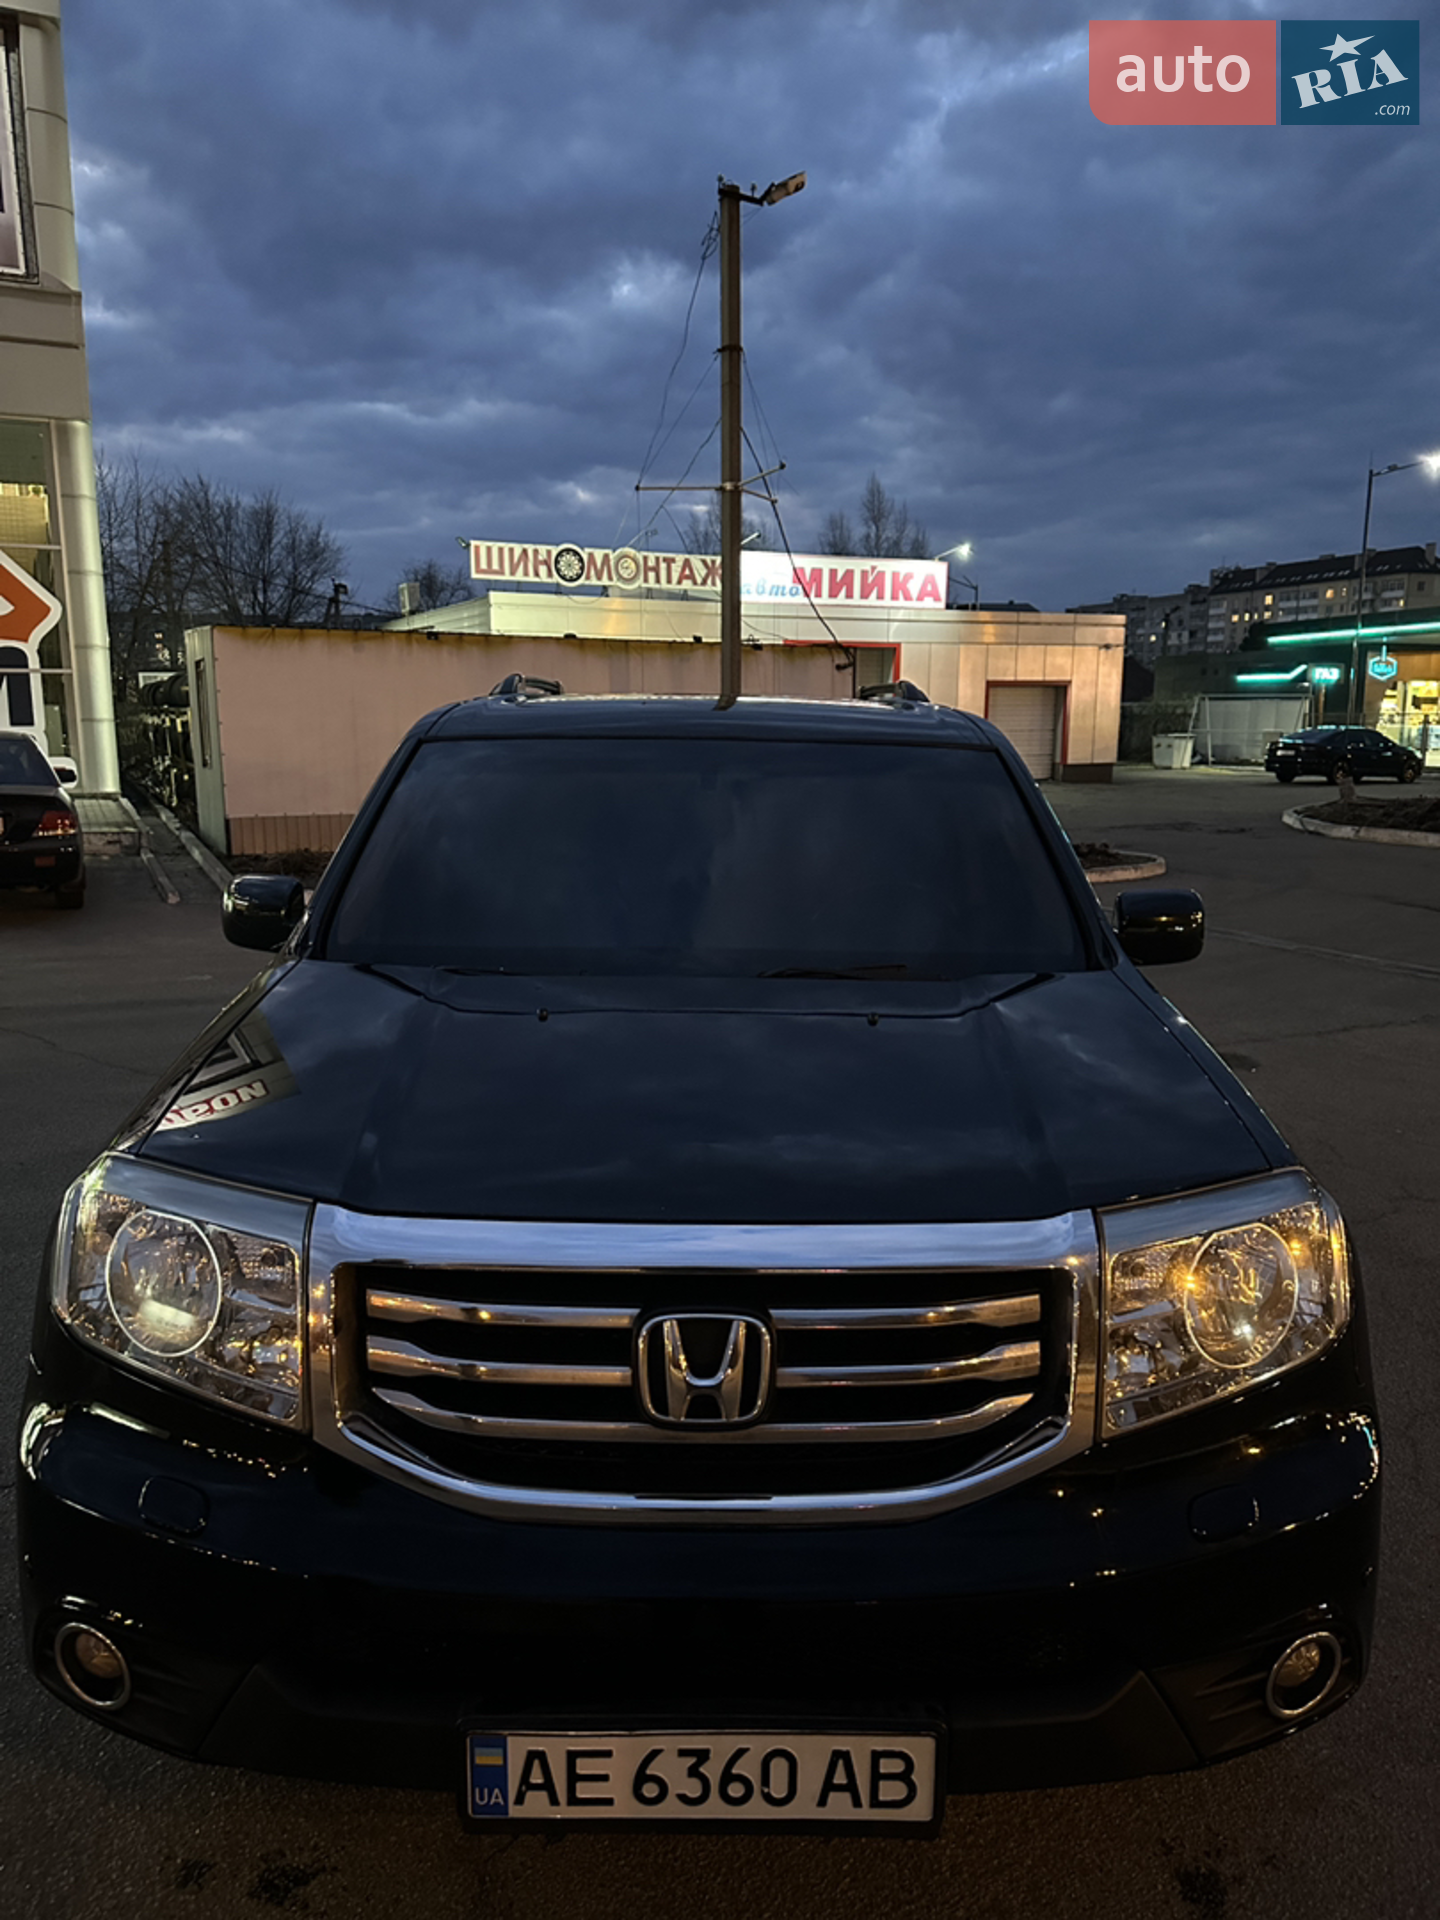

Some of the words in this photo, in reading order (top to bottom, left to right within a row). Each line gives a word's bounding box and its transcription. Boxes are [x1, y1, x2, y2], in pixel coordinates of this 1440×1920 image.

[474, 1787, 504, 1806] UA
[513, 1748, 615, 1807] AE
[632, 1748, 798, 1807] 6360
[816, 1749, 918, 1809] AB
